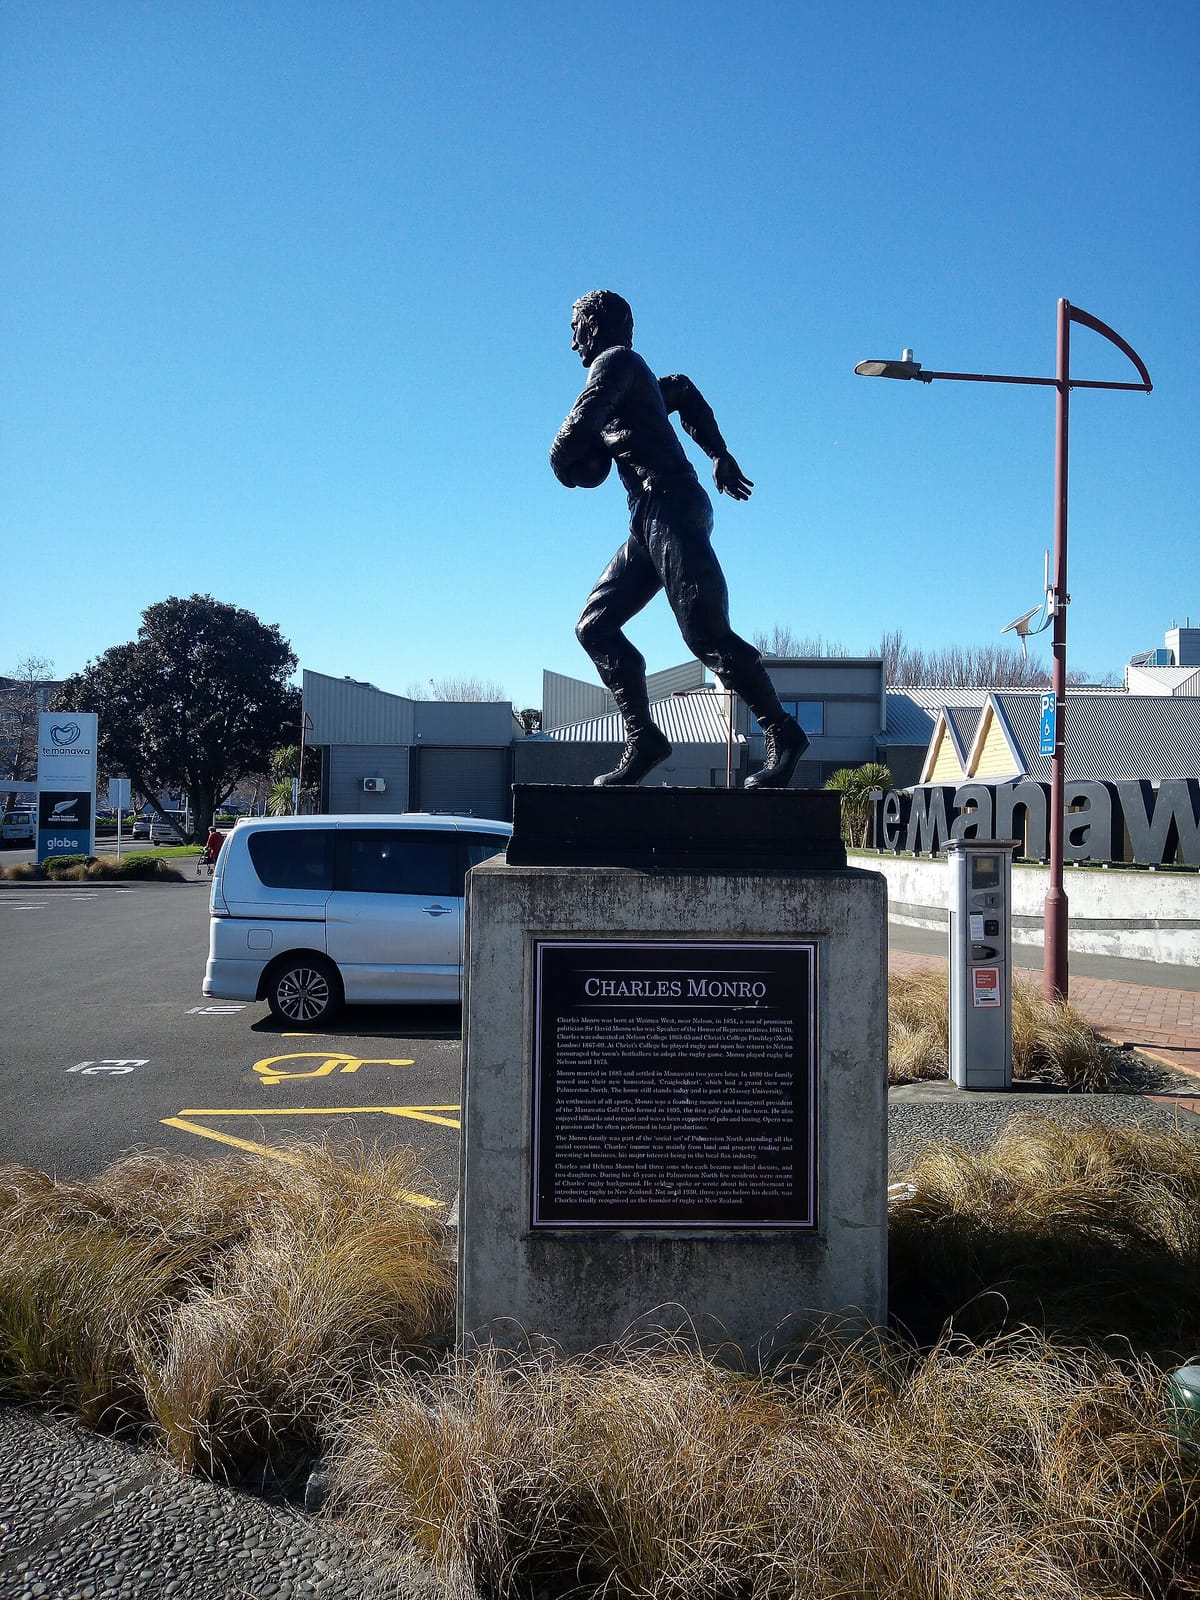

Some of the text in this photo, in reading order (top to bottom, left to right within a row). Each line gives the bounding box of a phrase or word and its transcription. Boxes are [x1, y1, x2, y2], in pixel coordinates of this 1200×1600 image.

[47, 837, 79, 850] globe
[584, 978, 767, 998] CHARLES MONRO
